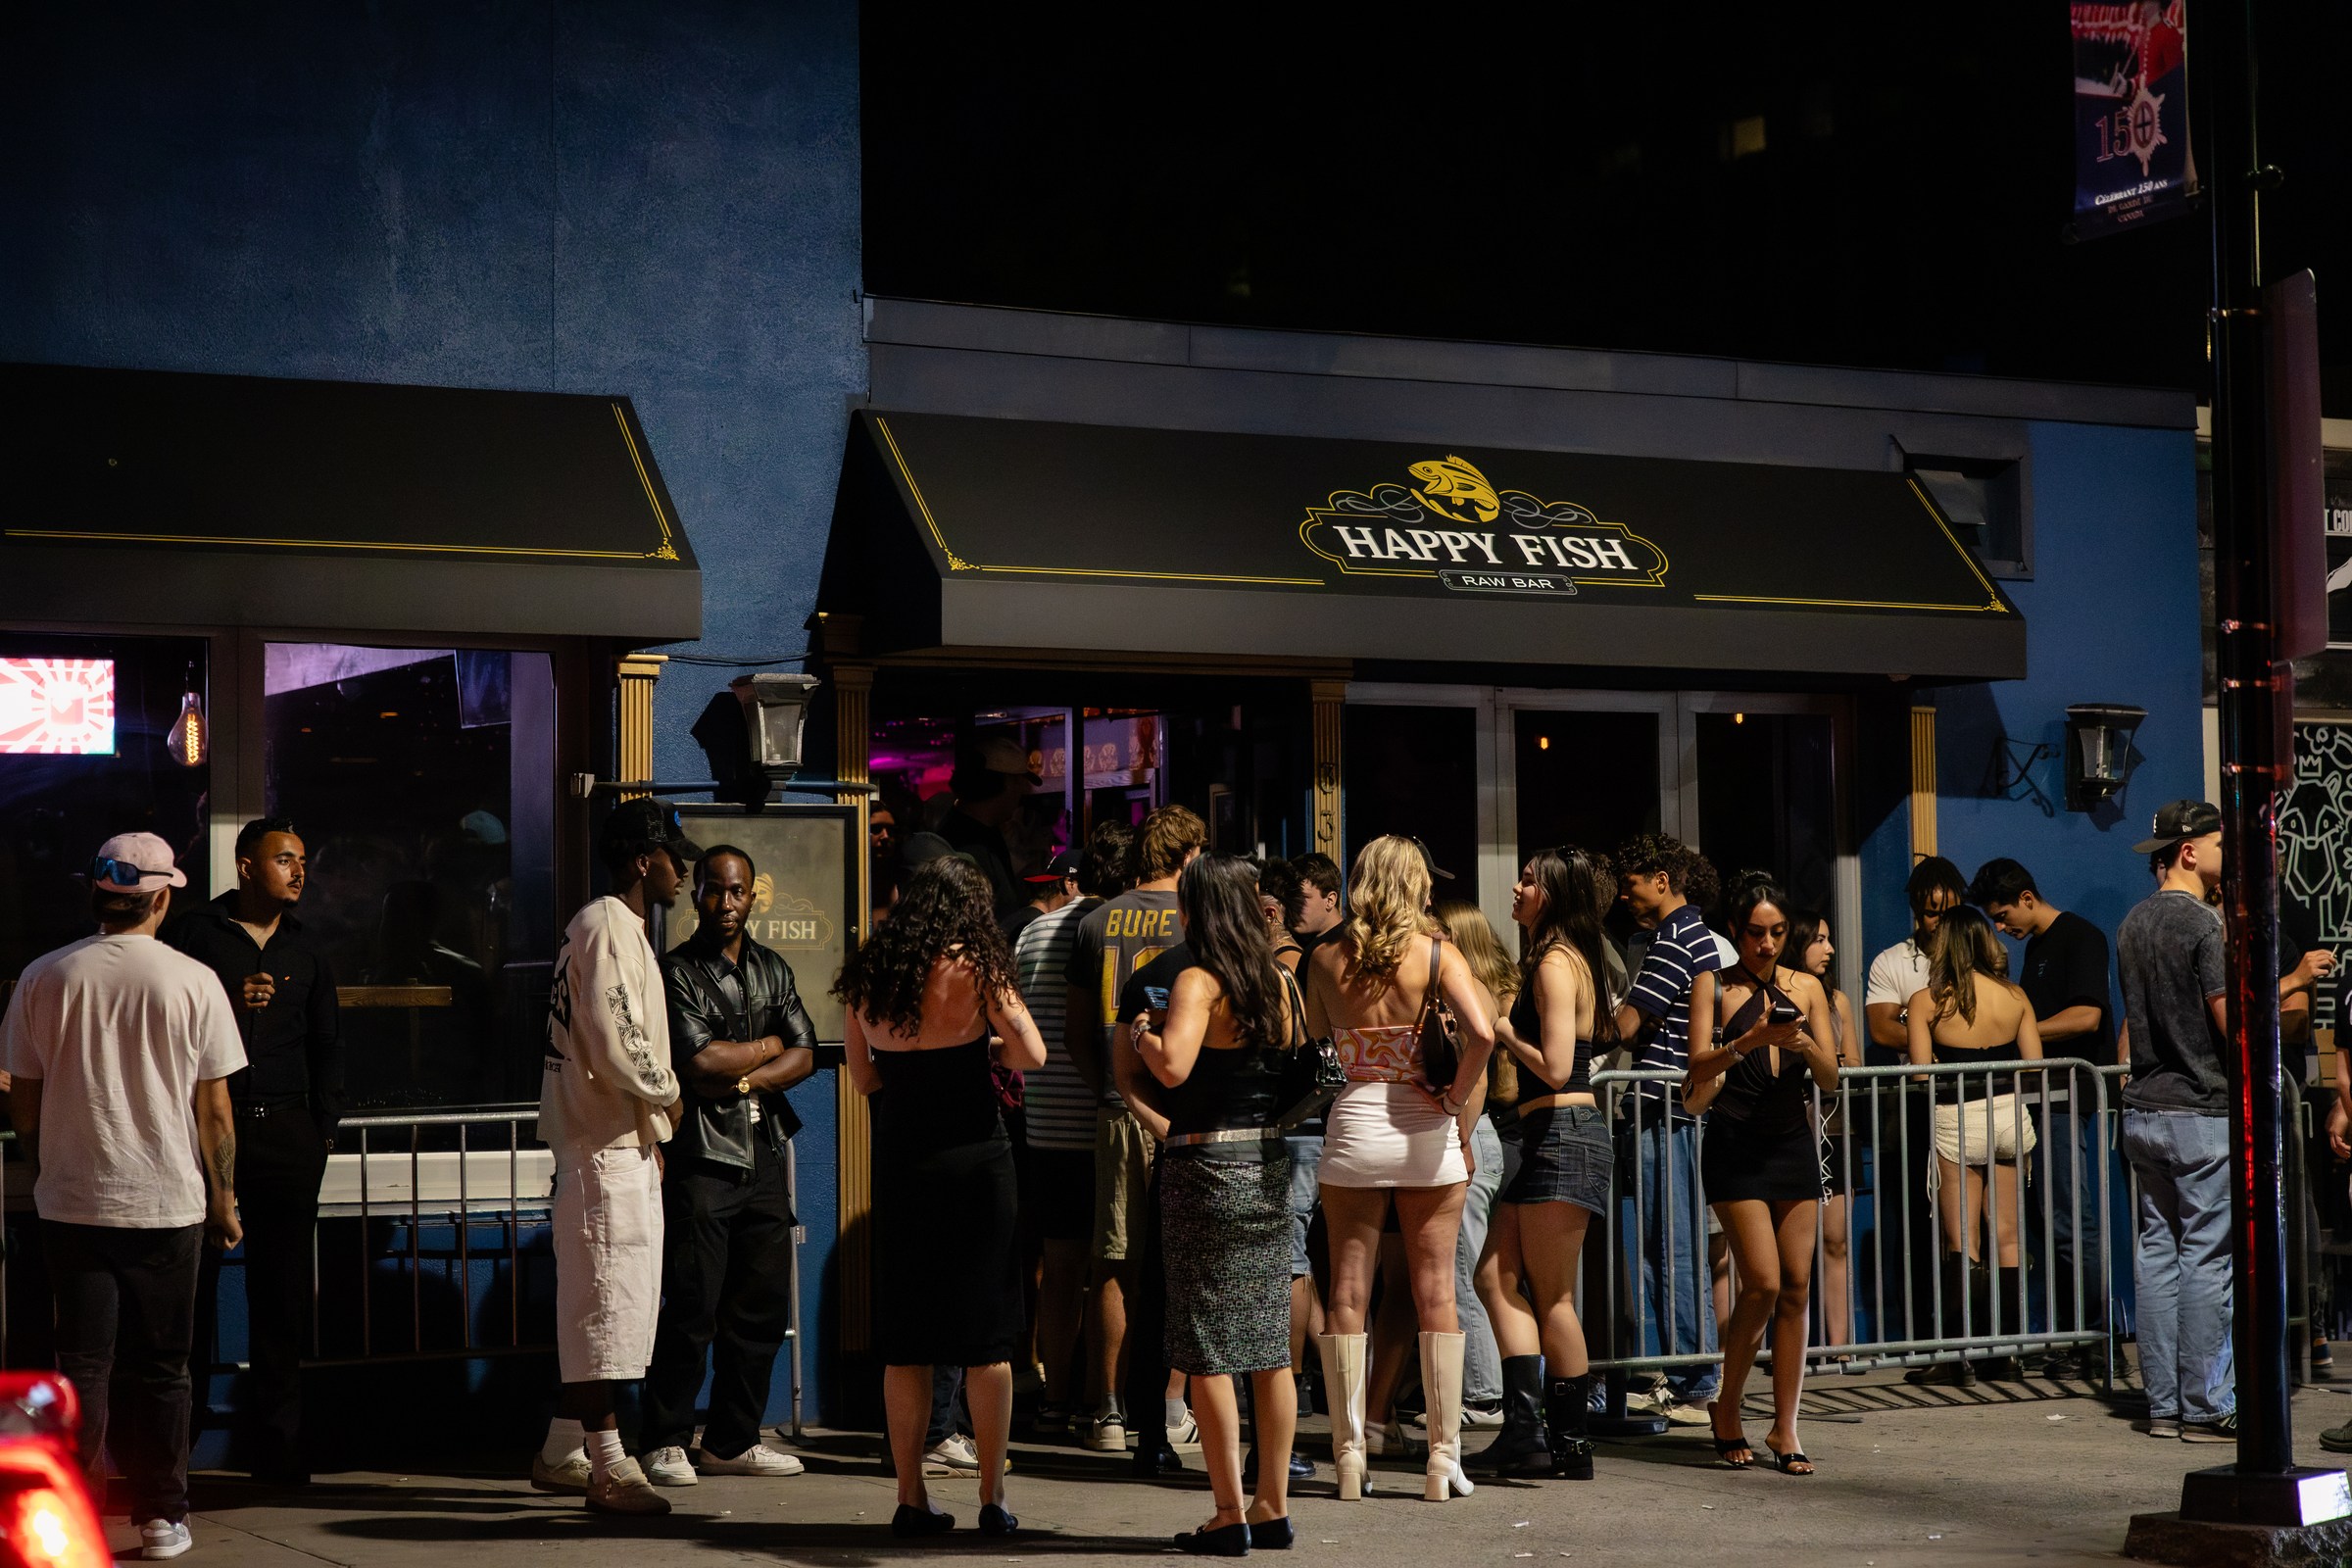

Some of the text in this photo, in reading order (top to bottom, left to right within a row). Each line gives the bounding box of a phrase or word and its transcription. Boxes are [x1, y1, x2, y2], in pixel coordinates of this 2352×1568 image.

[2095, 100, 2156, 163] 150
[1332, 525, 1639, 570] HAPPY FISH
[1462, 575, 1555, 590] RAW BAR
[768, 920, 817, 940] FISH
[1104, 908, 1178, 938] BURE
